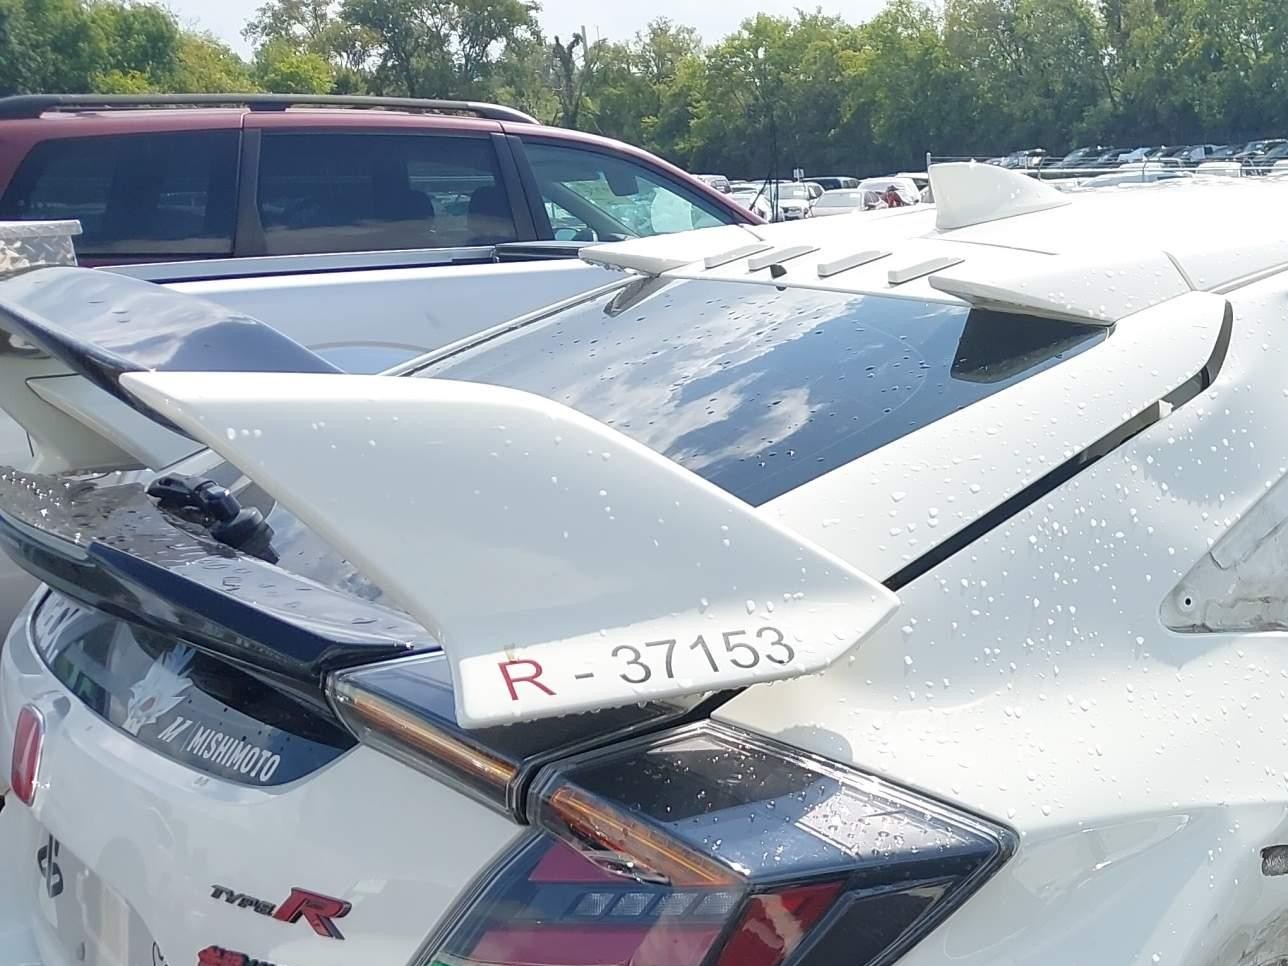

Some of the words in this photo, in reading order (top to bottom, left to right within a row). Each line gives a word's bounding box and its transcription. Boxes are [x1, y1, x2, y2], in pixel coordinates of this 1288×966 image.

[498, 659, 557, 701] R
[611, 627, 796, 685] 37153
[186, 725, 281, 782] MISHIMOTO
[211, 884, 276, 917] TYPE
[272, 887, 353, 941] R
